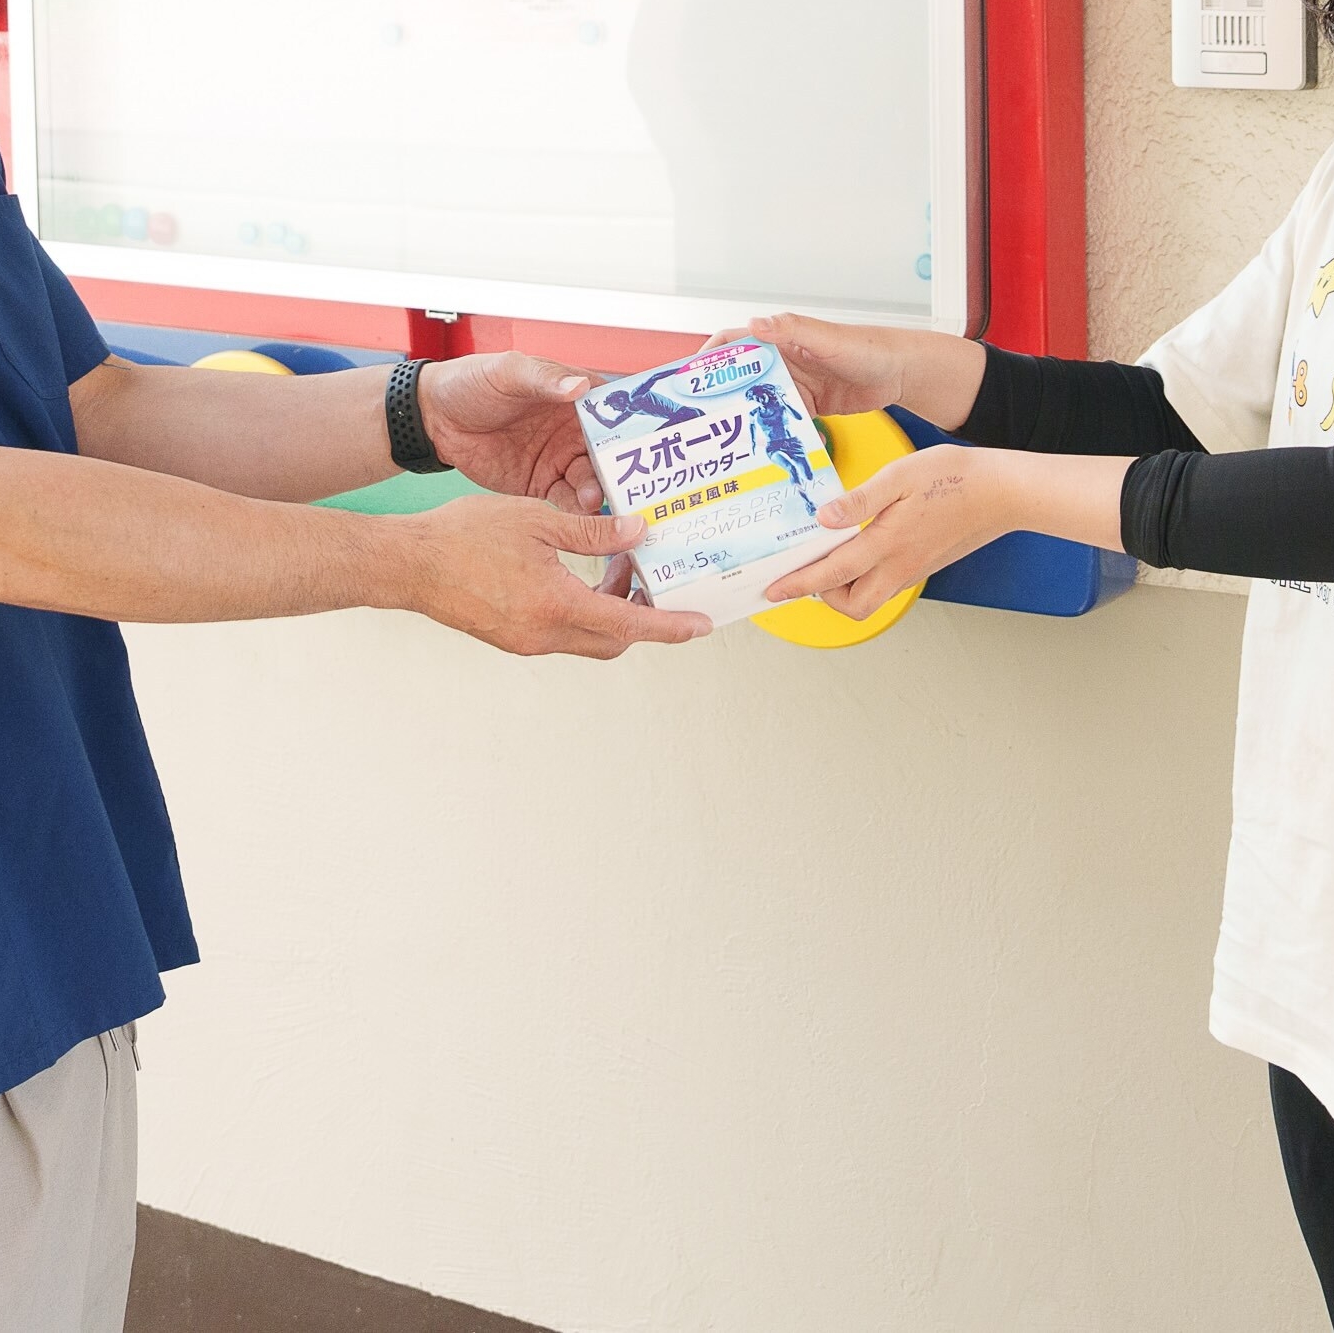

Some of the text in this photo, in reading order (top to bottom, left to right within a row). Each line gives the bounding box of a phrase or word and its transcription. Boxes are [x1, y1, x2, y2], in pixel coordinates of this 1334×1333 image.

[690, 360, 762, 394] 2,200mg
[703, 357, 737, 374] クエン酸
[616, 414, 743, 486] スポーツ
[626, 451, 750, 506] ドリンクパウダー
[654, 479, 740, 520] 日向夏風味
[644, 475, 826, 547] SPORTS DRINK
[685, 503, 784, 547] POWDER
